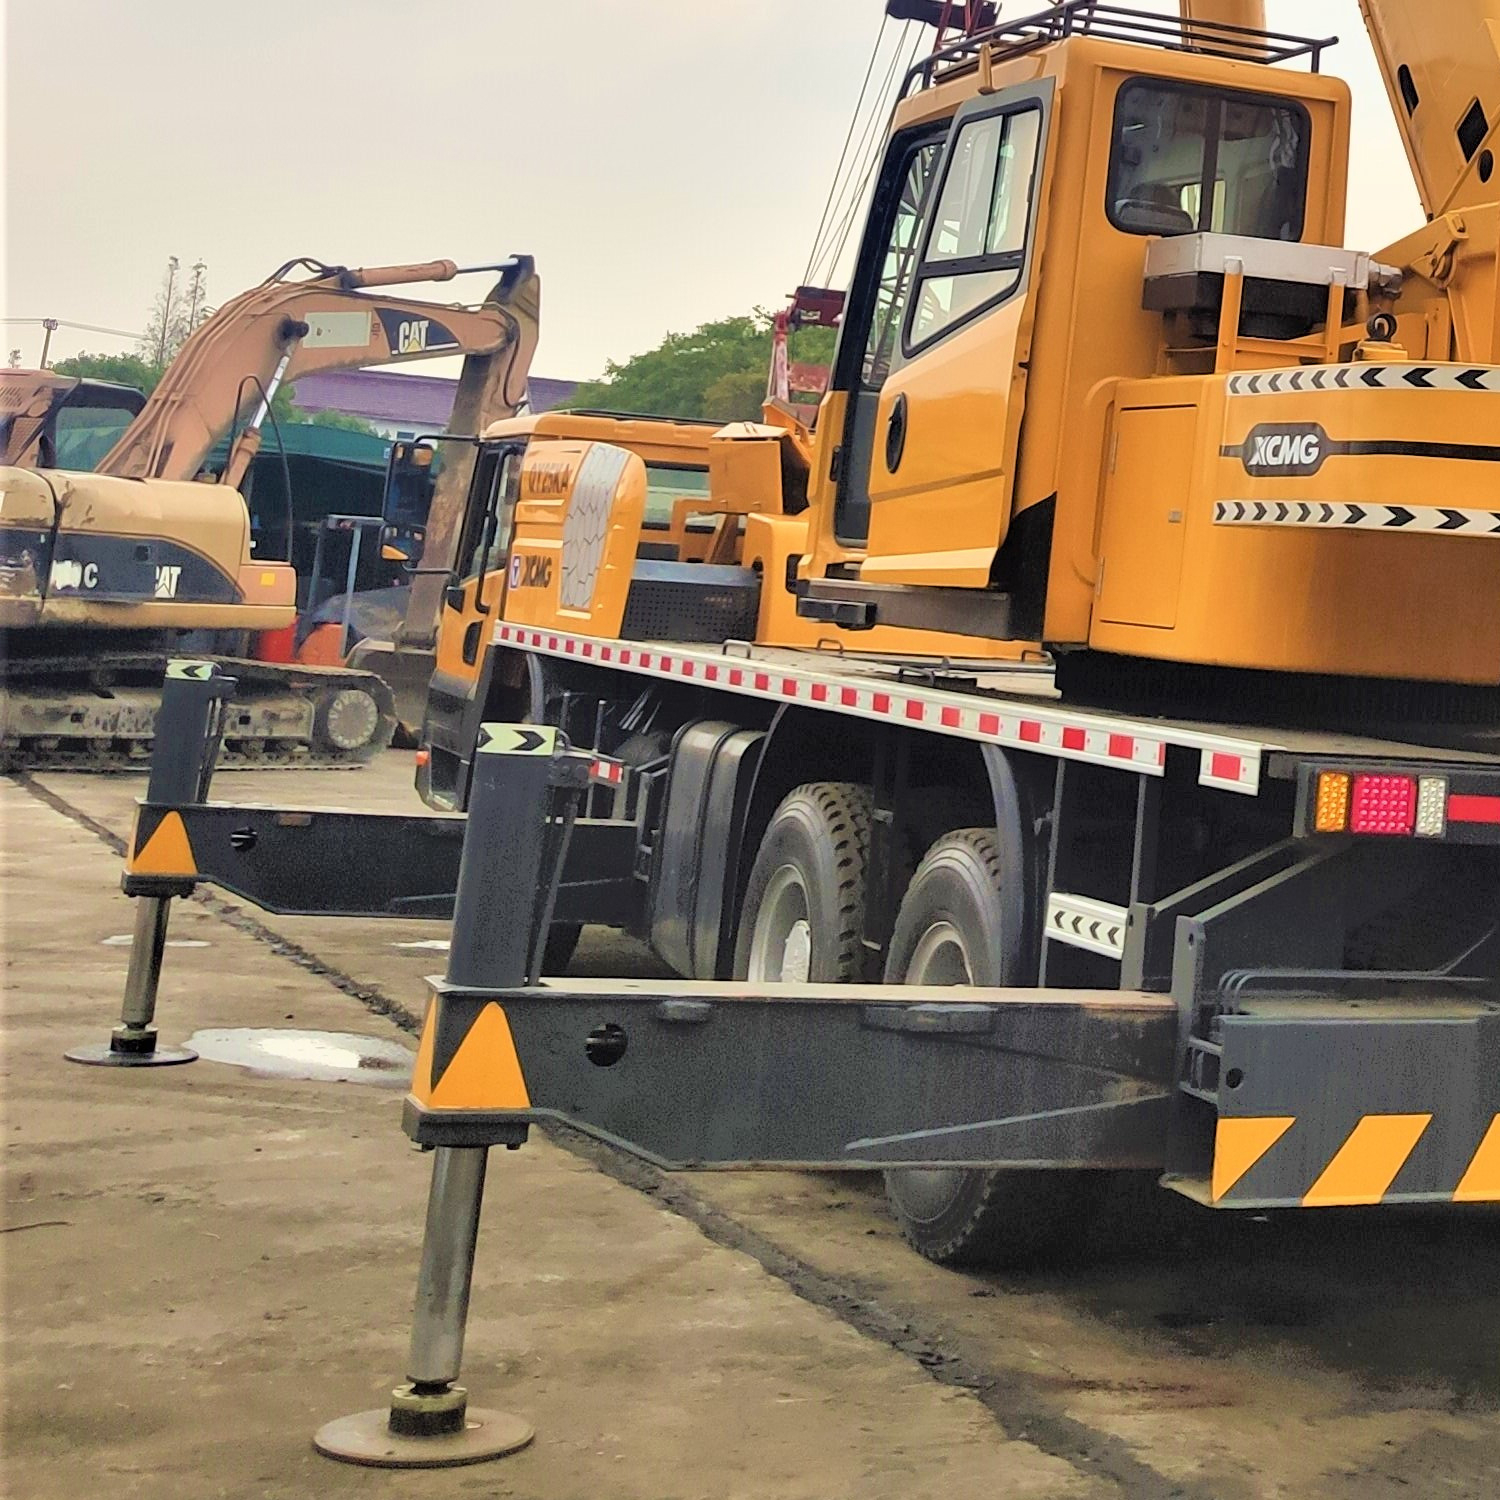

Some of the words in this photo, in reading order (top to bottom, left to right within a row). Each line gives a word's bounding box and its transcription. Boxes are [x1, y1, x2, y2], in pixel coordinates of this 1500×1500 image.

[398, 320, 430, 354] CAT
[1247, 434, 1320, 466] XCMG
[155, 566, 182, 598] AT
[521, 554, 553, 588] XCMG
